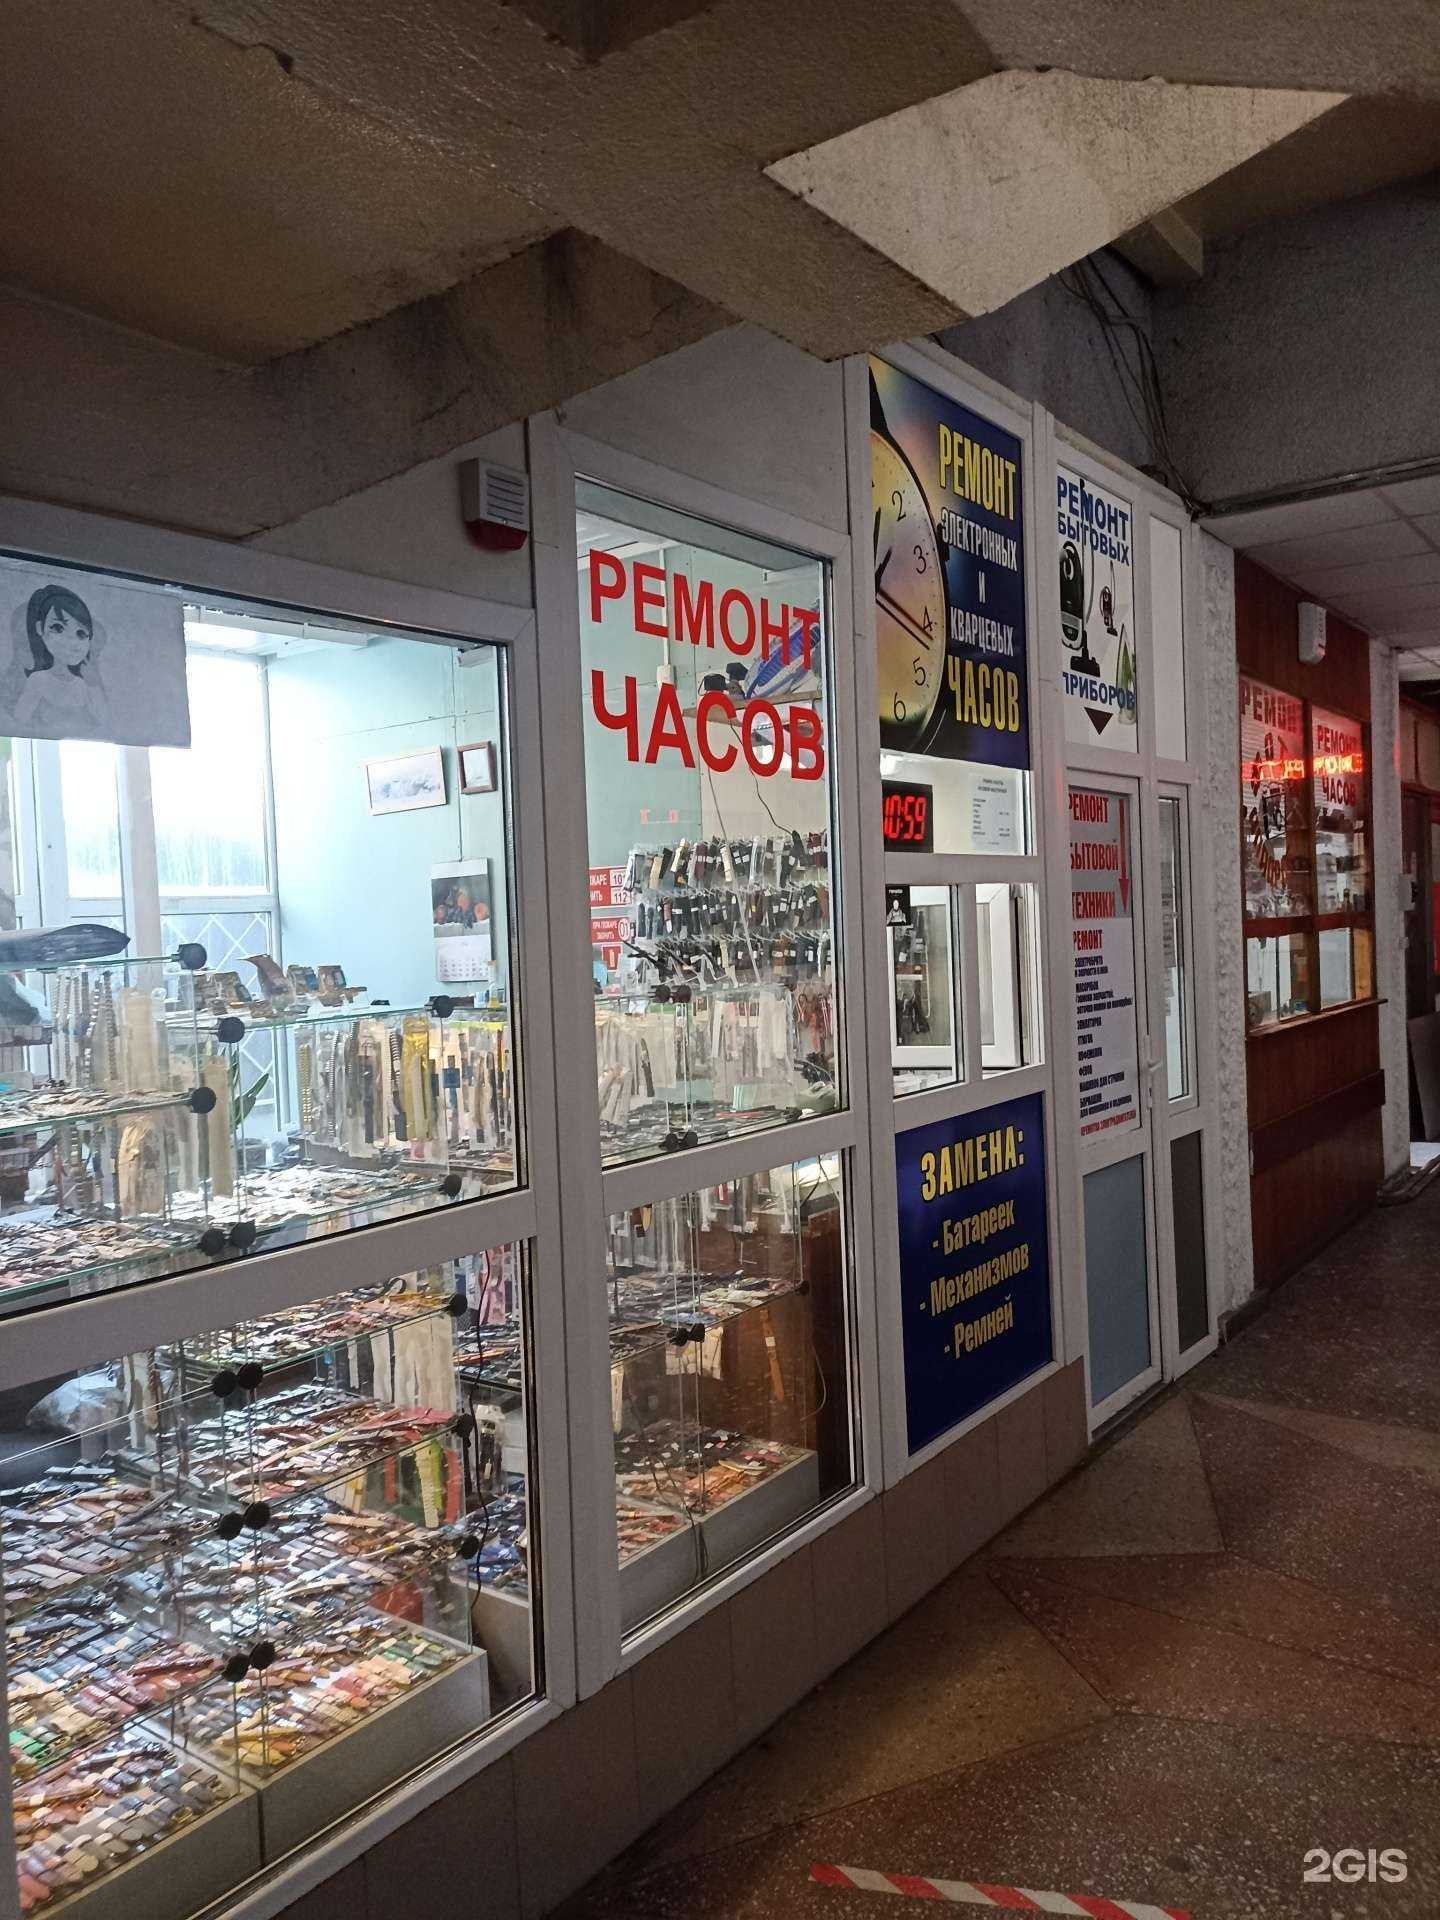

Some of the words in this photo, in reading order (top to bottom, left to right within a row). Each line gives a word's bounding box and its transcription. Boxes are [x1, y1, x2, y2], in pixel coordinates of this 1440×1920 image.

[940, 422, 1016, 520] РЕМОНТ
[891, 490, 906, 521] 2
[1057, 475, 1129, 541] РЕМОНТ
[913, 545, 927, 574] 3
[942, 507, 1017, 571] ЭЛЕКТРОННЫХ
[1057, 511, 1130, 567] БЫТОВЫХ
[589, 548, 821, 670] РЕМОНТ
[978, 570, 986, 604] И
[950, 606, 1014, 657] КВАРЦЕВЫХ
[913, 657, 926, 686] 5
[948, 654, 1020, 732] ЧАСОВ
[591, 668, 825, 781] ЧАСОВ
[893, 692, 906, 721] 6
[1317, 724, 1357, 755] РЕМОНТ
[884, 795, 926, 839] 10:59
[1322, 775, 1356, 807] ЧАСОВ
[614, 892, 628, 903] 112
[921, 1125, 1025, 1202] ЗАМЕНА:
[943, 1199, 1015, 1256] Батареек
[930, 1243, 1030, 1317] Механизмов
[954, 1293, 1014, 1360] Ремней
